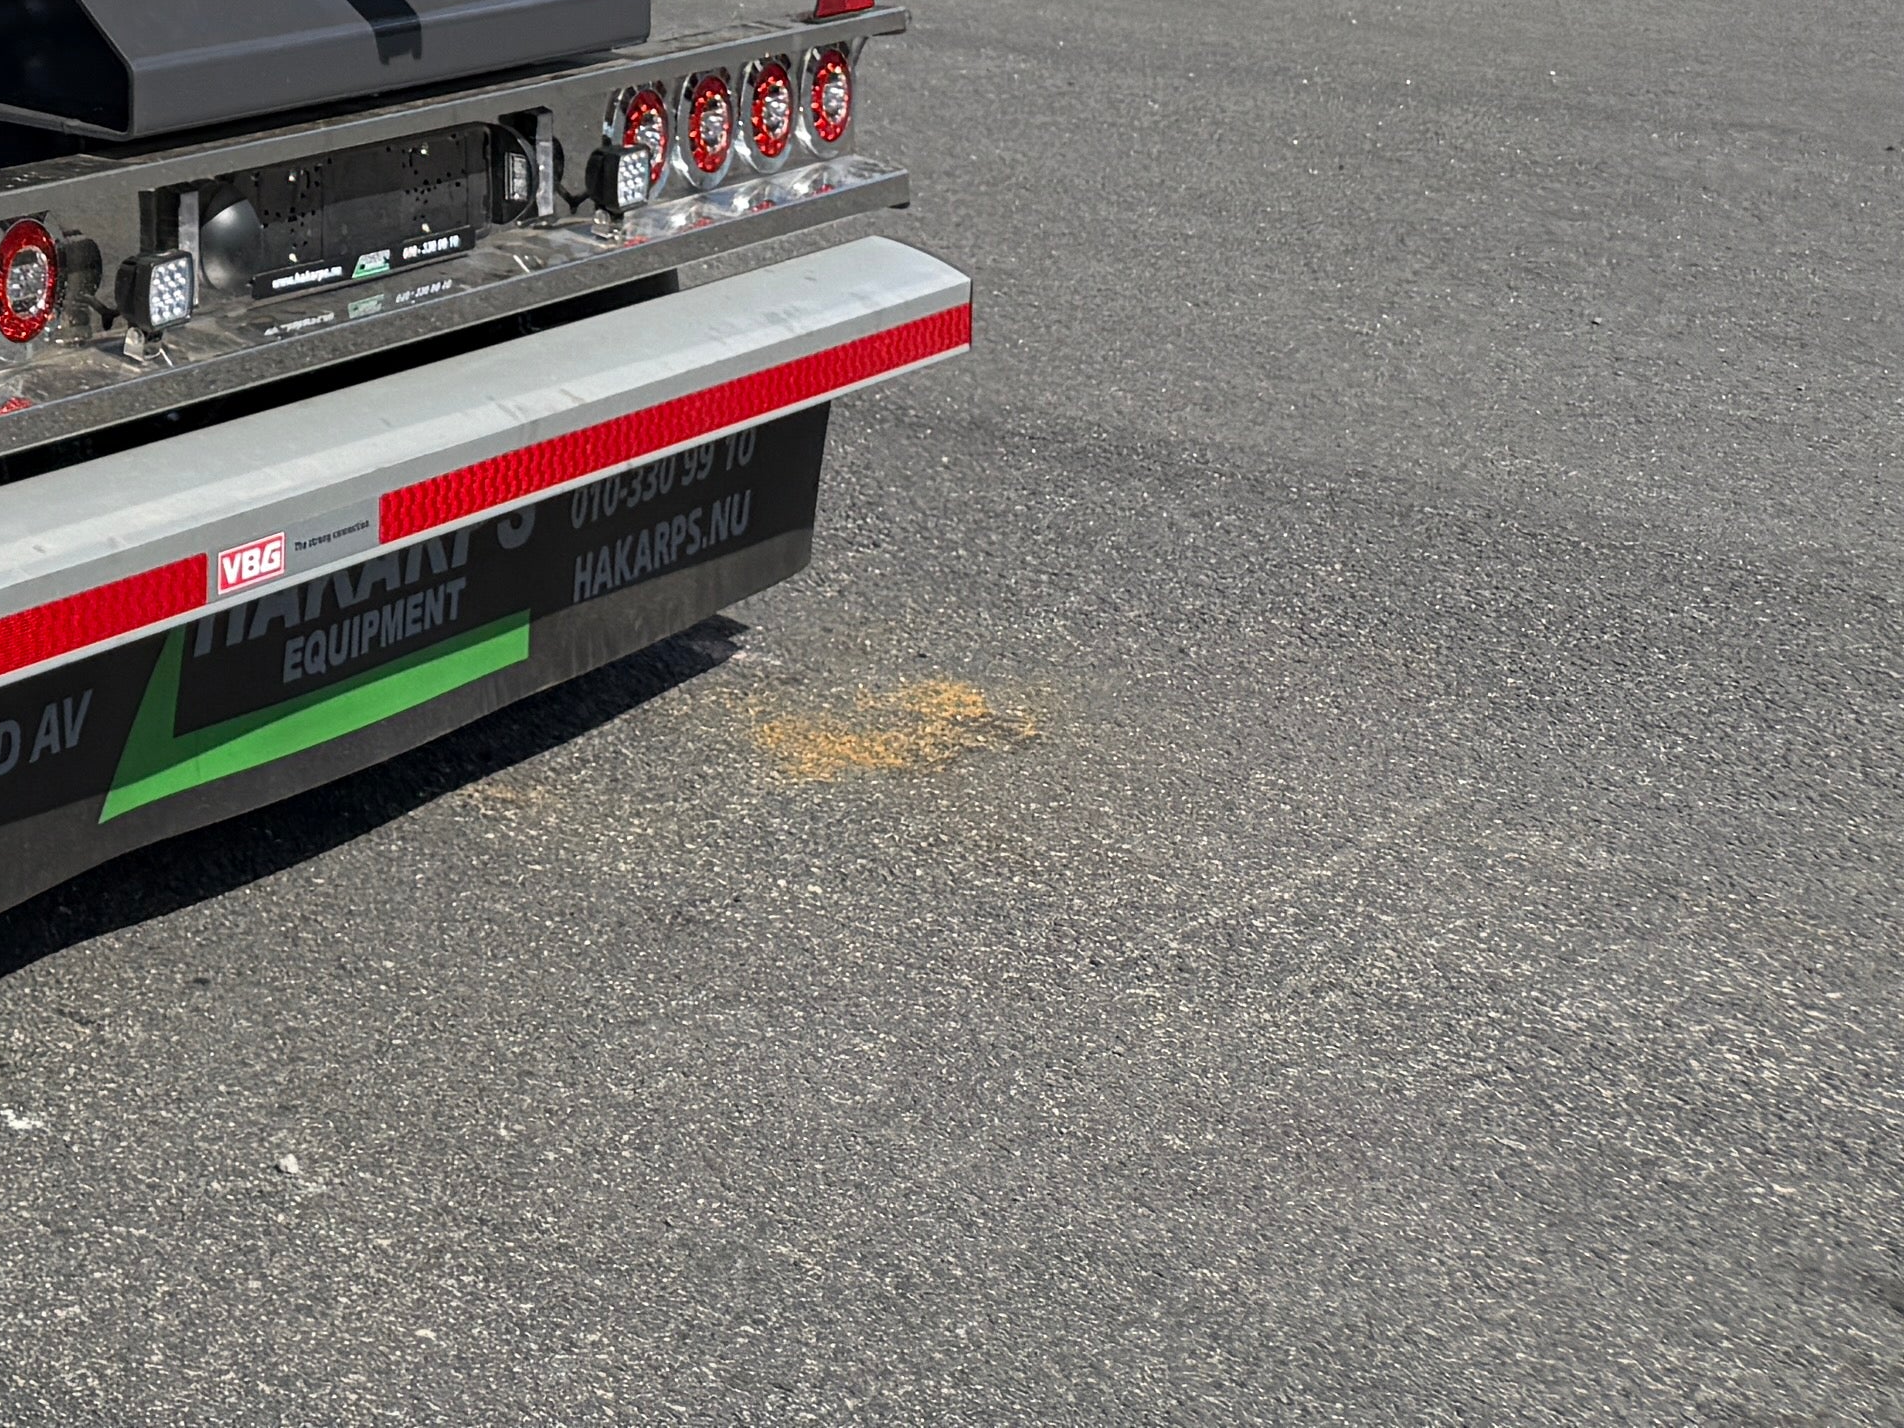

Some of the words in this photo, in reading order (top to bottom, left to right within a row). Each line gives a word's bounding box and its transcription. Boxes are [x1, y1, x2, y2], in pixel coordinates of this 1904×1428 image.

[222, 539, 282, 585] VBG
[573, 488, 752, 603] HAKARPS.NU
[283, 577, 468, 684] EQUIPMENT
[29, 688, 92, 764] AV
